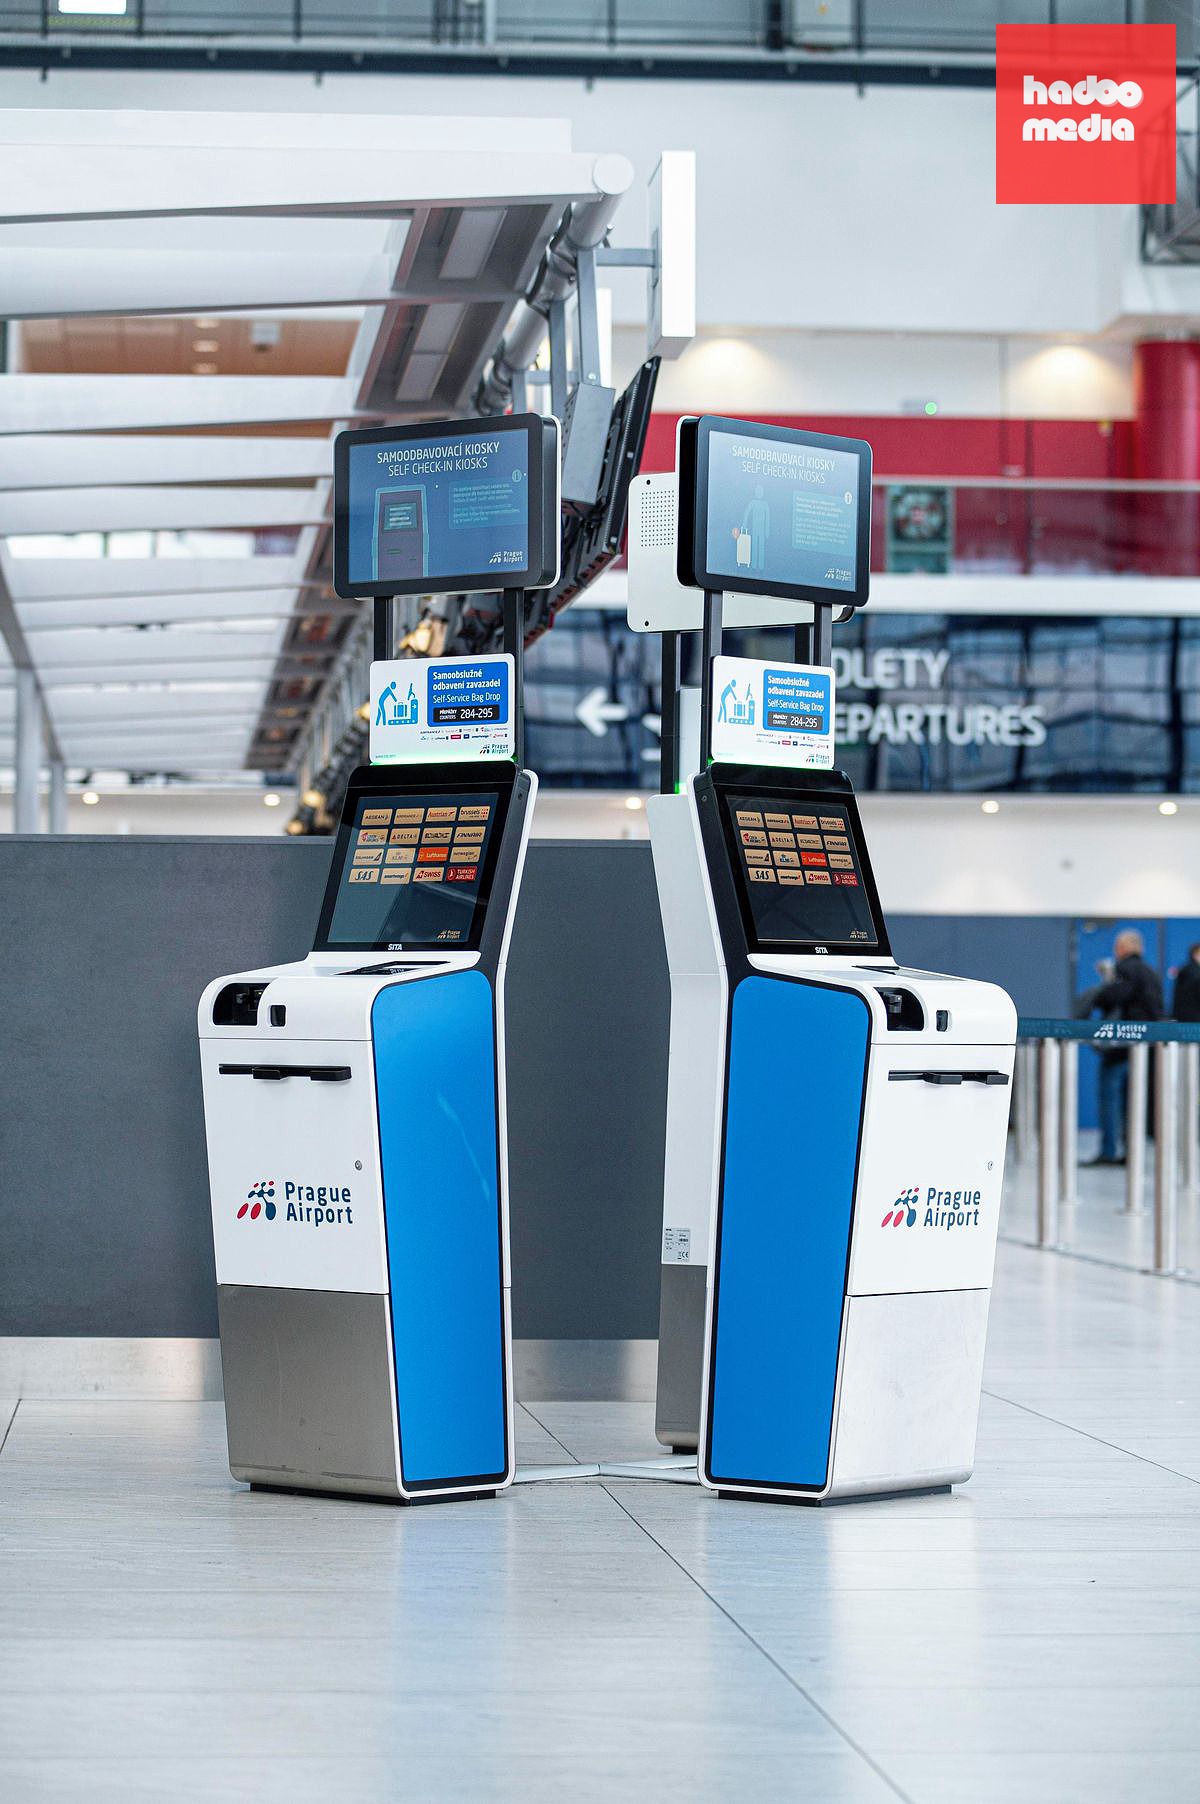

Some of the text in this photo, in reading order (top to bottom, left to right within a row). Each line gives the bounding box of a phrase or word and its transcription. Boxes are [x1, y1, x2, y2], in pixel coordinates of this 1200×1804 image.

[377, 442, 500, 463] SAMOODBAVOVACÍ KIOSKY
[732, 446, 835, 472] SAMOODBAVOVACÍ KIOSKY
[388, 457, 488, 476] SELF CHECK-IN KIOSKS
[742, 461, 825, 483] SELF CHECK-IN KIOSKS
[433, 669, 482, 680] Samoobslužné
[433, 679, 500, 690] odbavení zavazadel
[433, 693, 500, 703] Self-Service Bag Drop
[796, 690, 824, 698] zavazadel
[768, 699, 824, 712] Self-Service Bag Drop
[460, 708, 493, 719] 284-295
[791, 716, 817, 727] 284-295
[355, 871, 374, 880] SAS
[755, 871, 769, 880] SAS
[285, 1182, 351, 1206] Prague
[927, 1188, 981, 1210] Prague
[287, 1202, 353, 1227] Airport
[924, 1208, 979, 1230] Airport
